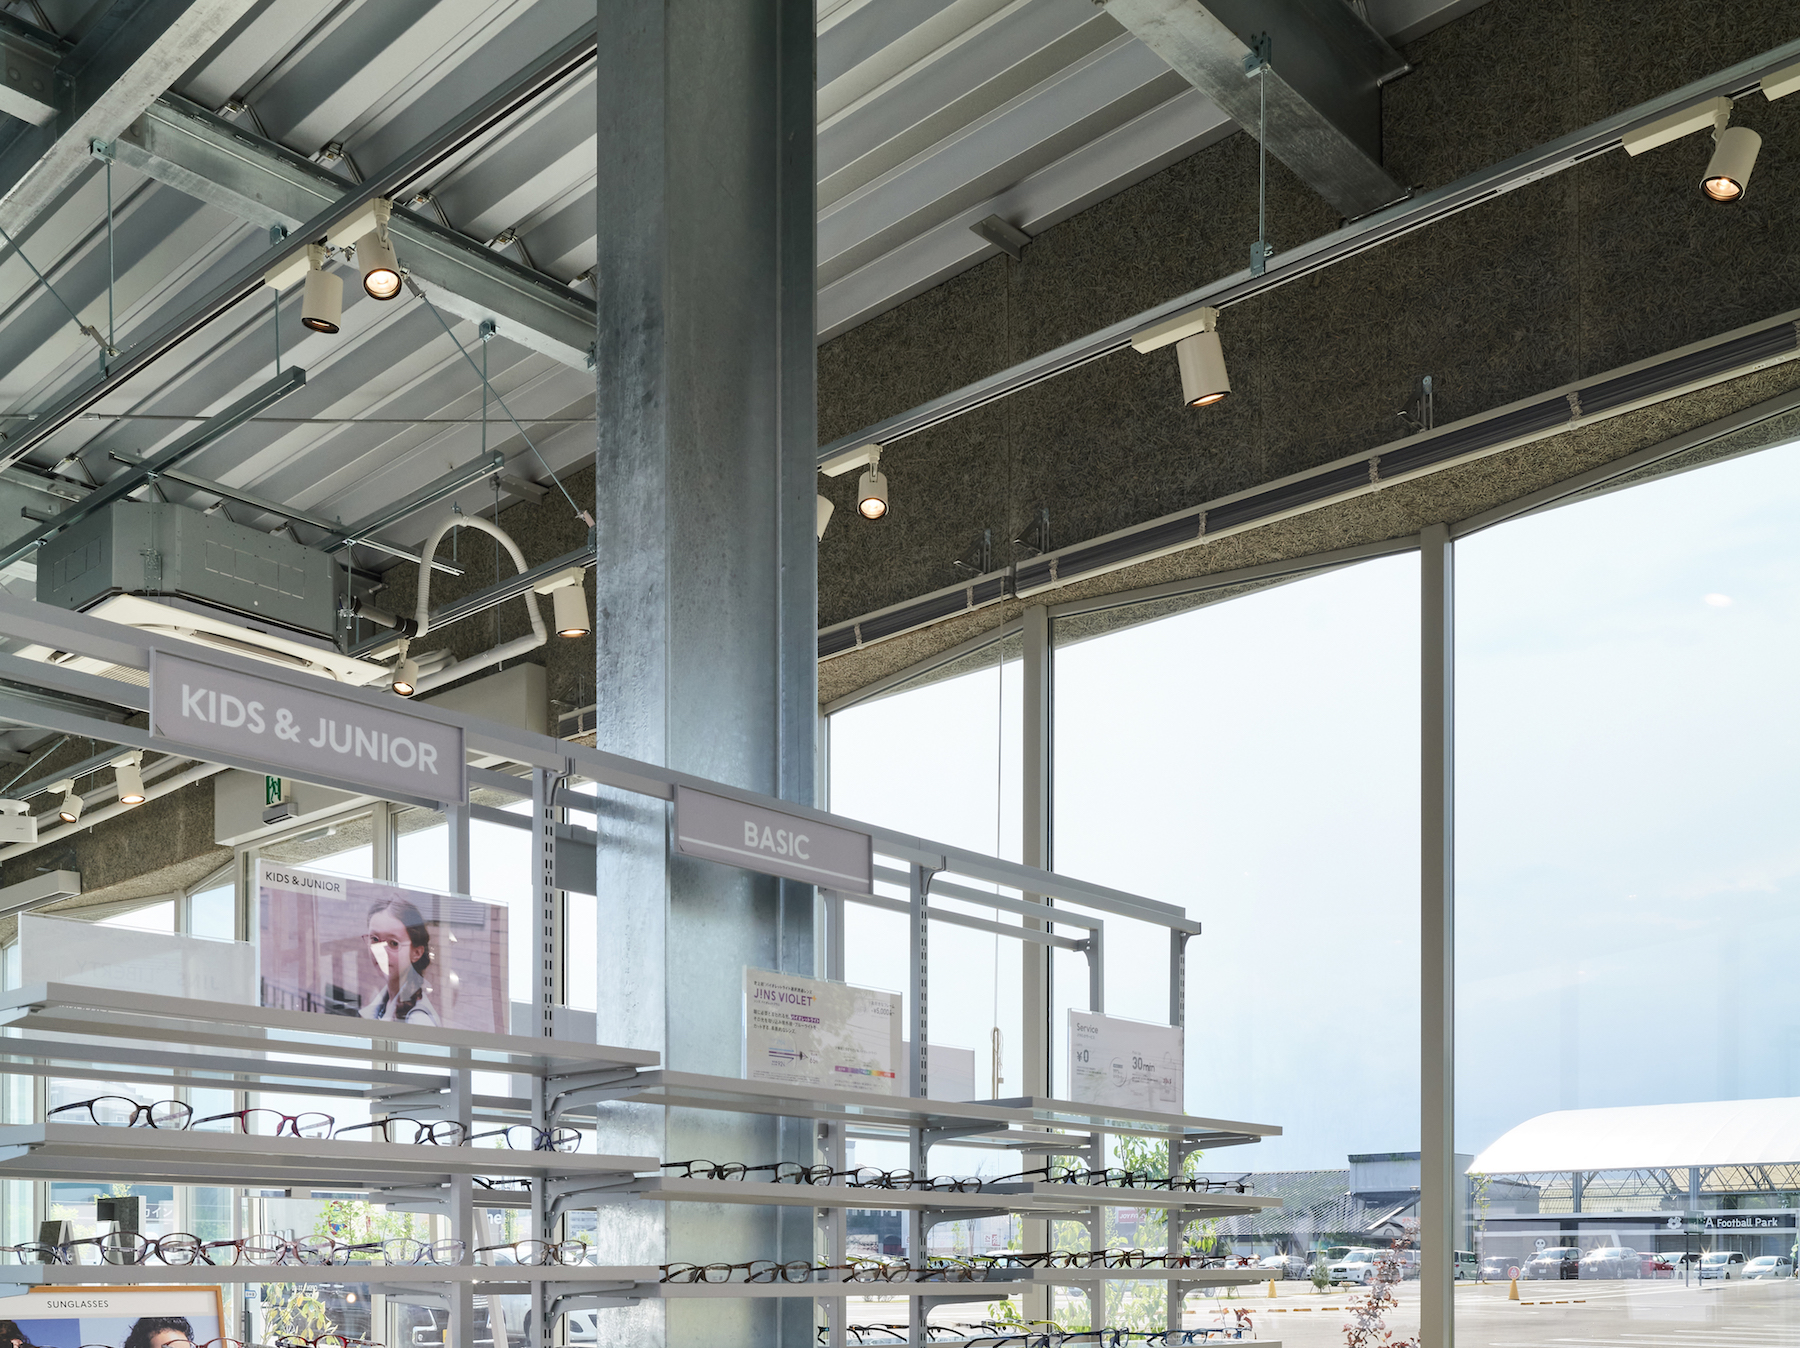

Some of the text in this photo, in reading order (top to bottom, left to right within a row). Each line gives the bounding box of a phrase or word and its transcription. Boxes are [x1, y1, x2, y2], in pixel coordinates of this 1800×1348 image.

[181, 684, 439, 776] KIDS & JUNIOR
[744, 820, 810, 860] BASIC
[265, 871, 341, 892] KIDS & JUNIOR
[1077, 1023, 1098, 1034] Service
[1716, 1217, 1753, 1228] Football
[1754, 1216, 1778, 1227] Park
[47, 1300, 109, 1309] SUNGLASSES
